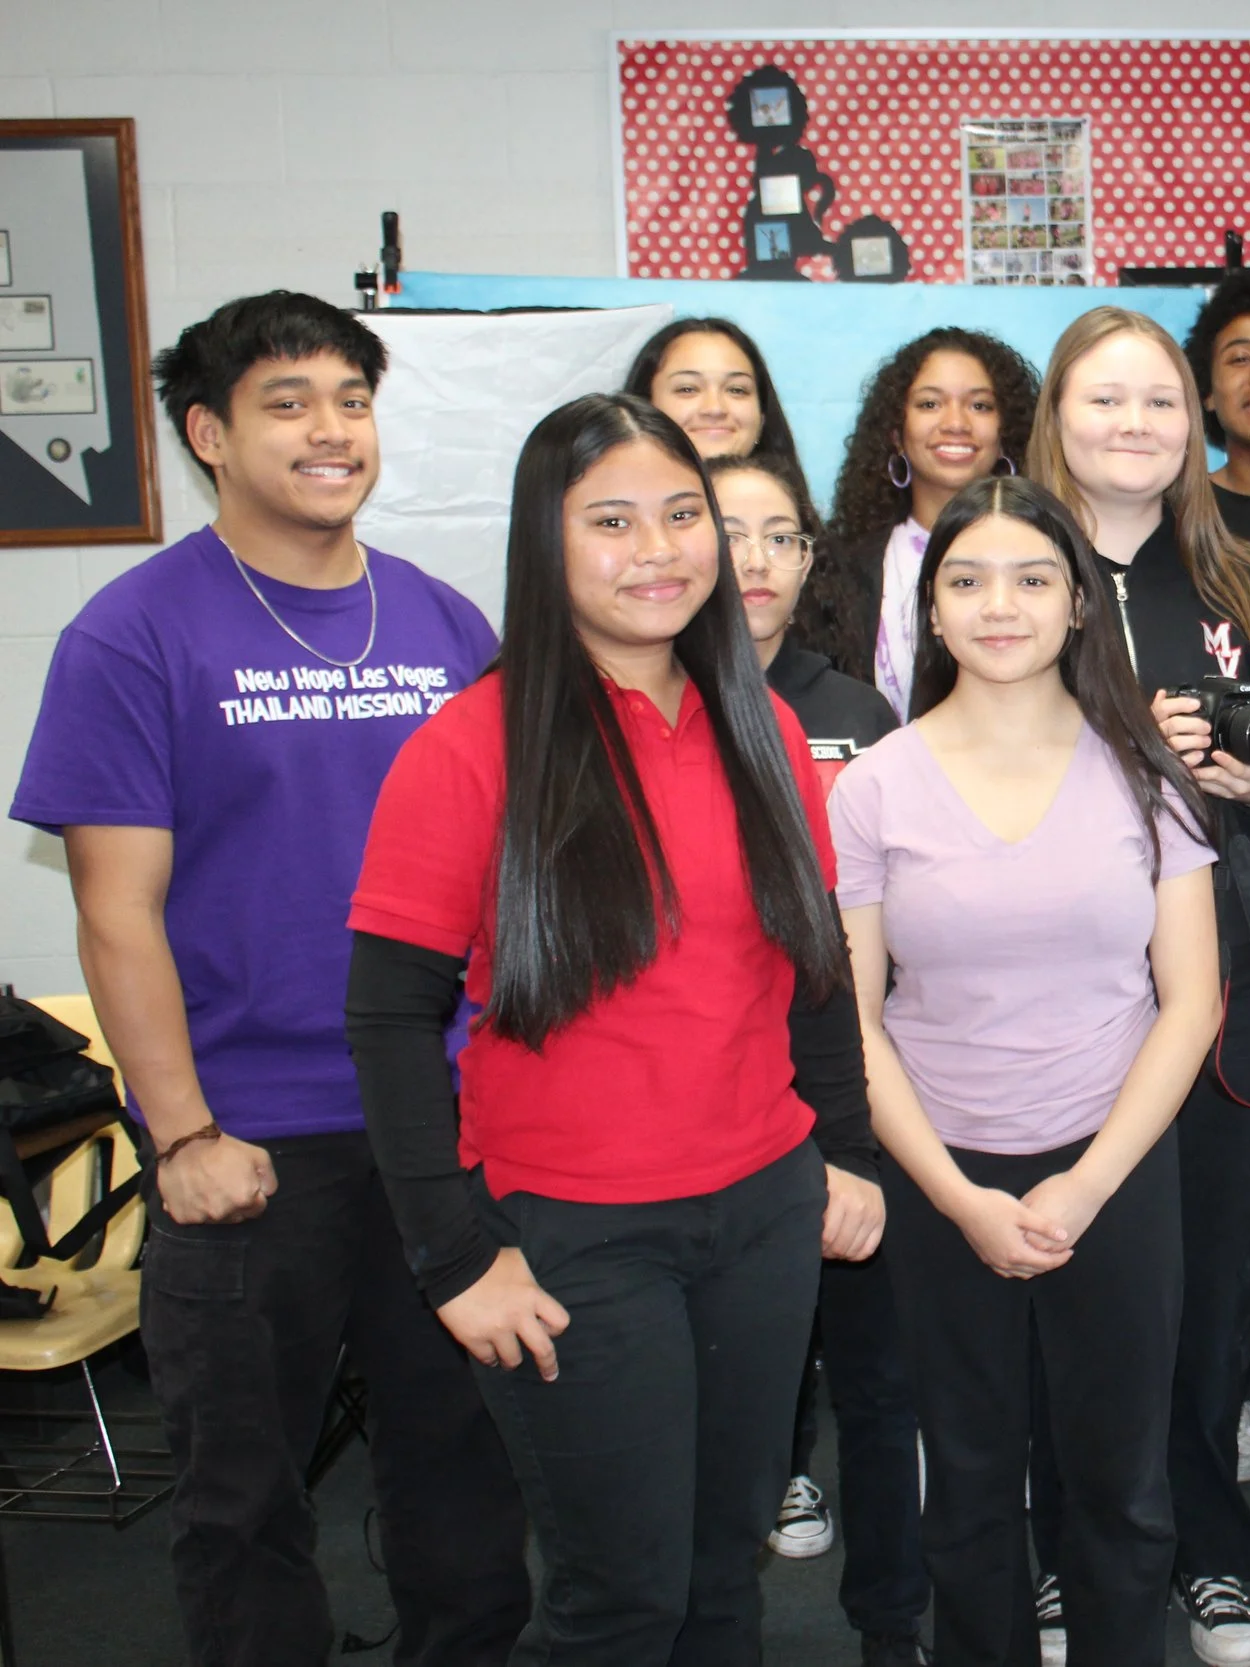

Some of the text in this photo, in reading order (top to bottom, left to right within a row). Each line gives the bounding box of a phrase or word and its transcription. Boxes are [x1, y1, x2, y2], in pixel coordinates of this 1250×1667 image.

[234, 664, 448, 693] New Hope Las Vegas
[219, 691, 457, 726] THAILAND MISSION 20
[810, 745, 844, 760] SCHOOL
